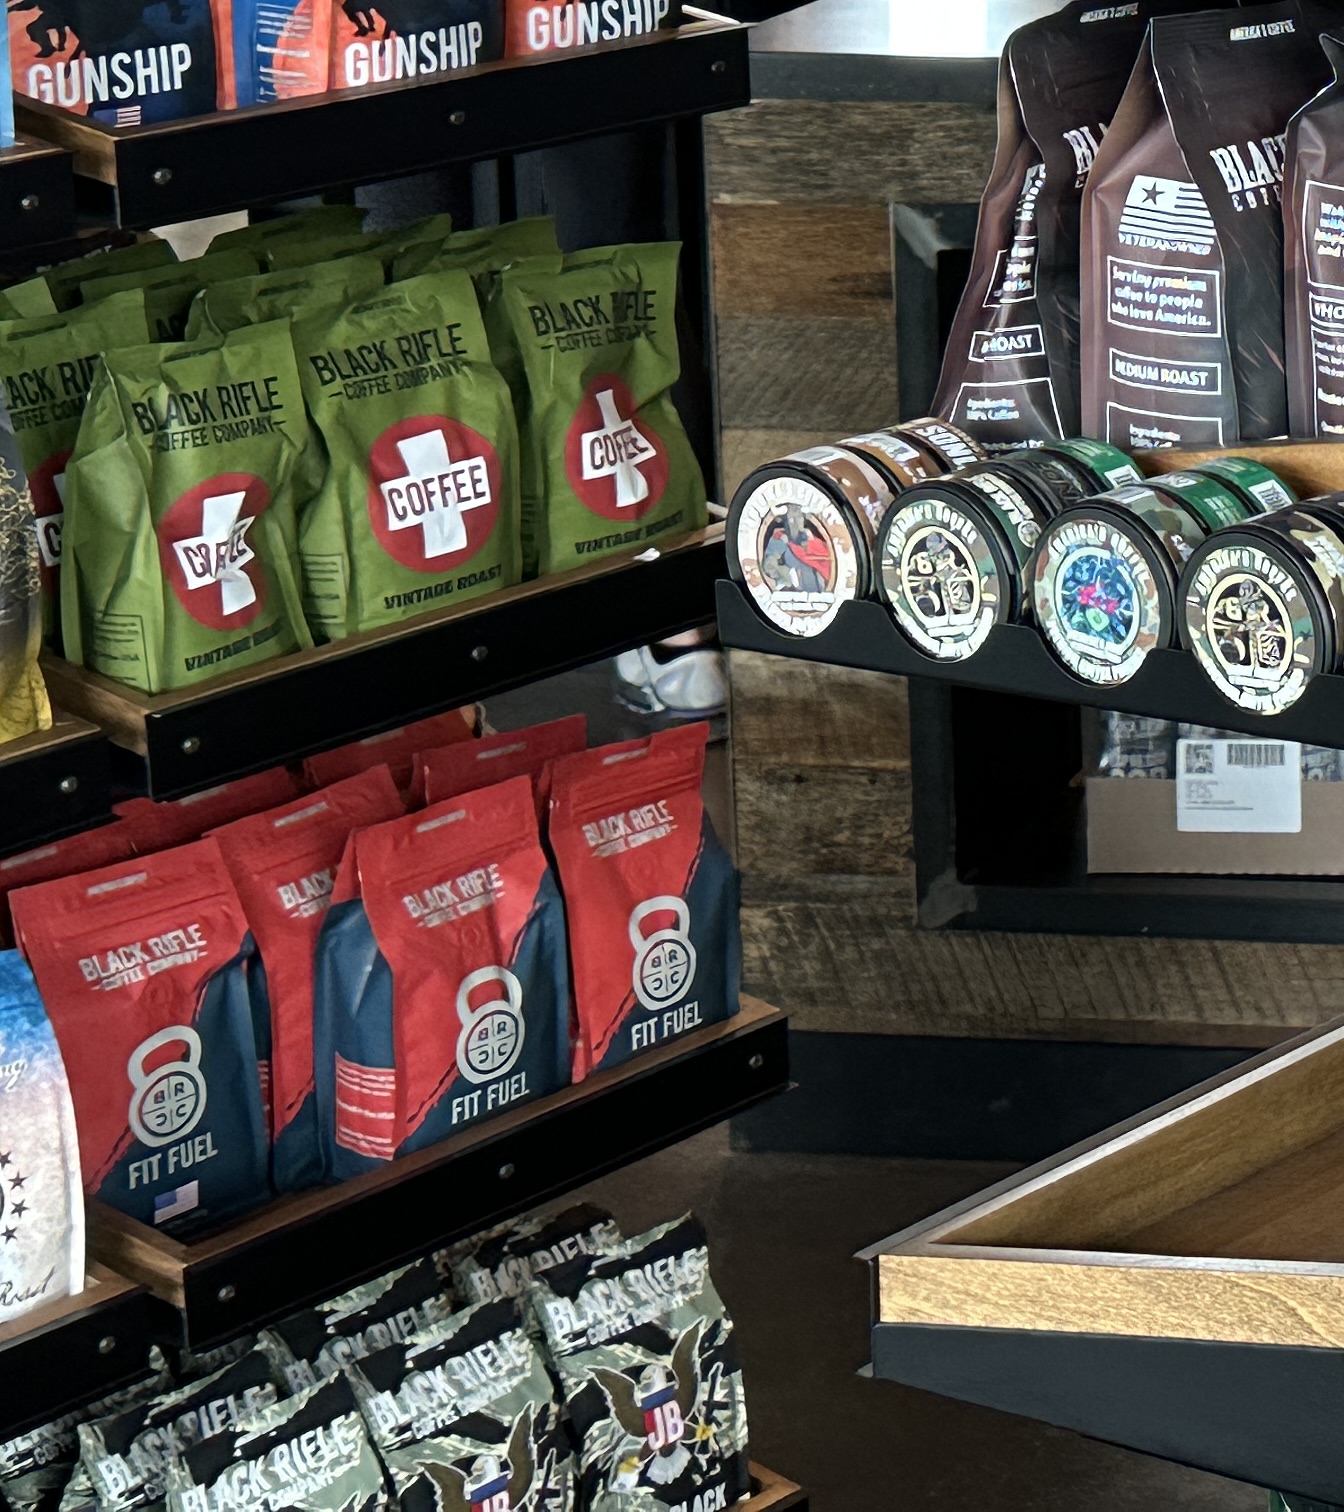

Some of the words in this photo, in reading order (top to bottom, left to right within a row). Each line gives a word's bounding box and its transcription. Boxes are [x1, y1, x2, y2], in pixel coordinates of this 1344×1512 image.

[27, 44, 192, 107] GUNSHIP
[344, 21, 484, 88] GUNSHIP
[527, 294, 611, 336] BLACK
[308, 341, 399, 386] BLACK
[396, 323, 468, 367] RIFLE
[1160, 365, 1209, 386] ROAST
[131, 388, 216, 436] BLACK
[214, 376, 284, 420] RIFLE
[387, 464, 488, 522] COFFEE
[382, 579, 454, 611] VINTAGE
[582, 811, 631, 851] BLACK
[629, 799, 675, 835] RIFLE
[403, 879, 458, 920] BLACK
[456, 864, 505, 902] RIFLE
[79, 938, 148, 984] BLACK
[147, 923, 207, 963] RIFLE
[629, 1019, 660, 1052] FIT
[663, 999, 703, 1035] FUEL
[450, 1092, 484, 1126] FIT
[487, 1070, 530, 1108] FUEL
[127, 1153, 163, 1190] FIT
[167, 1131, 219, 1172] FUEL
[546, 1276, 627, 1336] BLACK
[368, 1368, 456, 1434] BLACK
[649, 1400, 685, 1451] JB
[181, 1458, 272, 1512] BLACK
[270, 1412, 361, 1481] RIFLE
